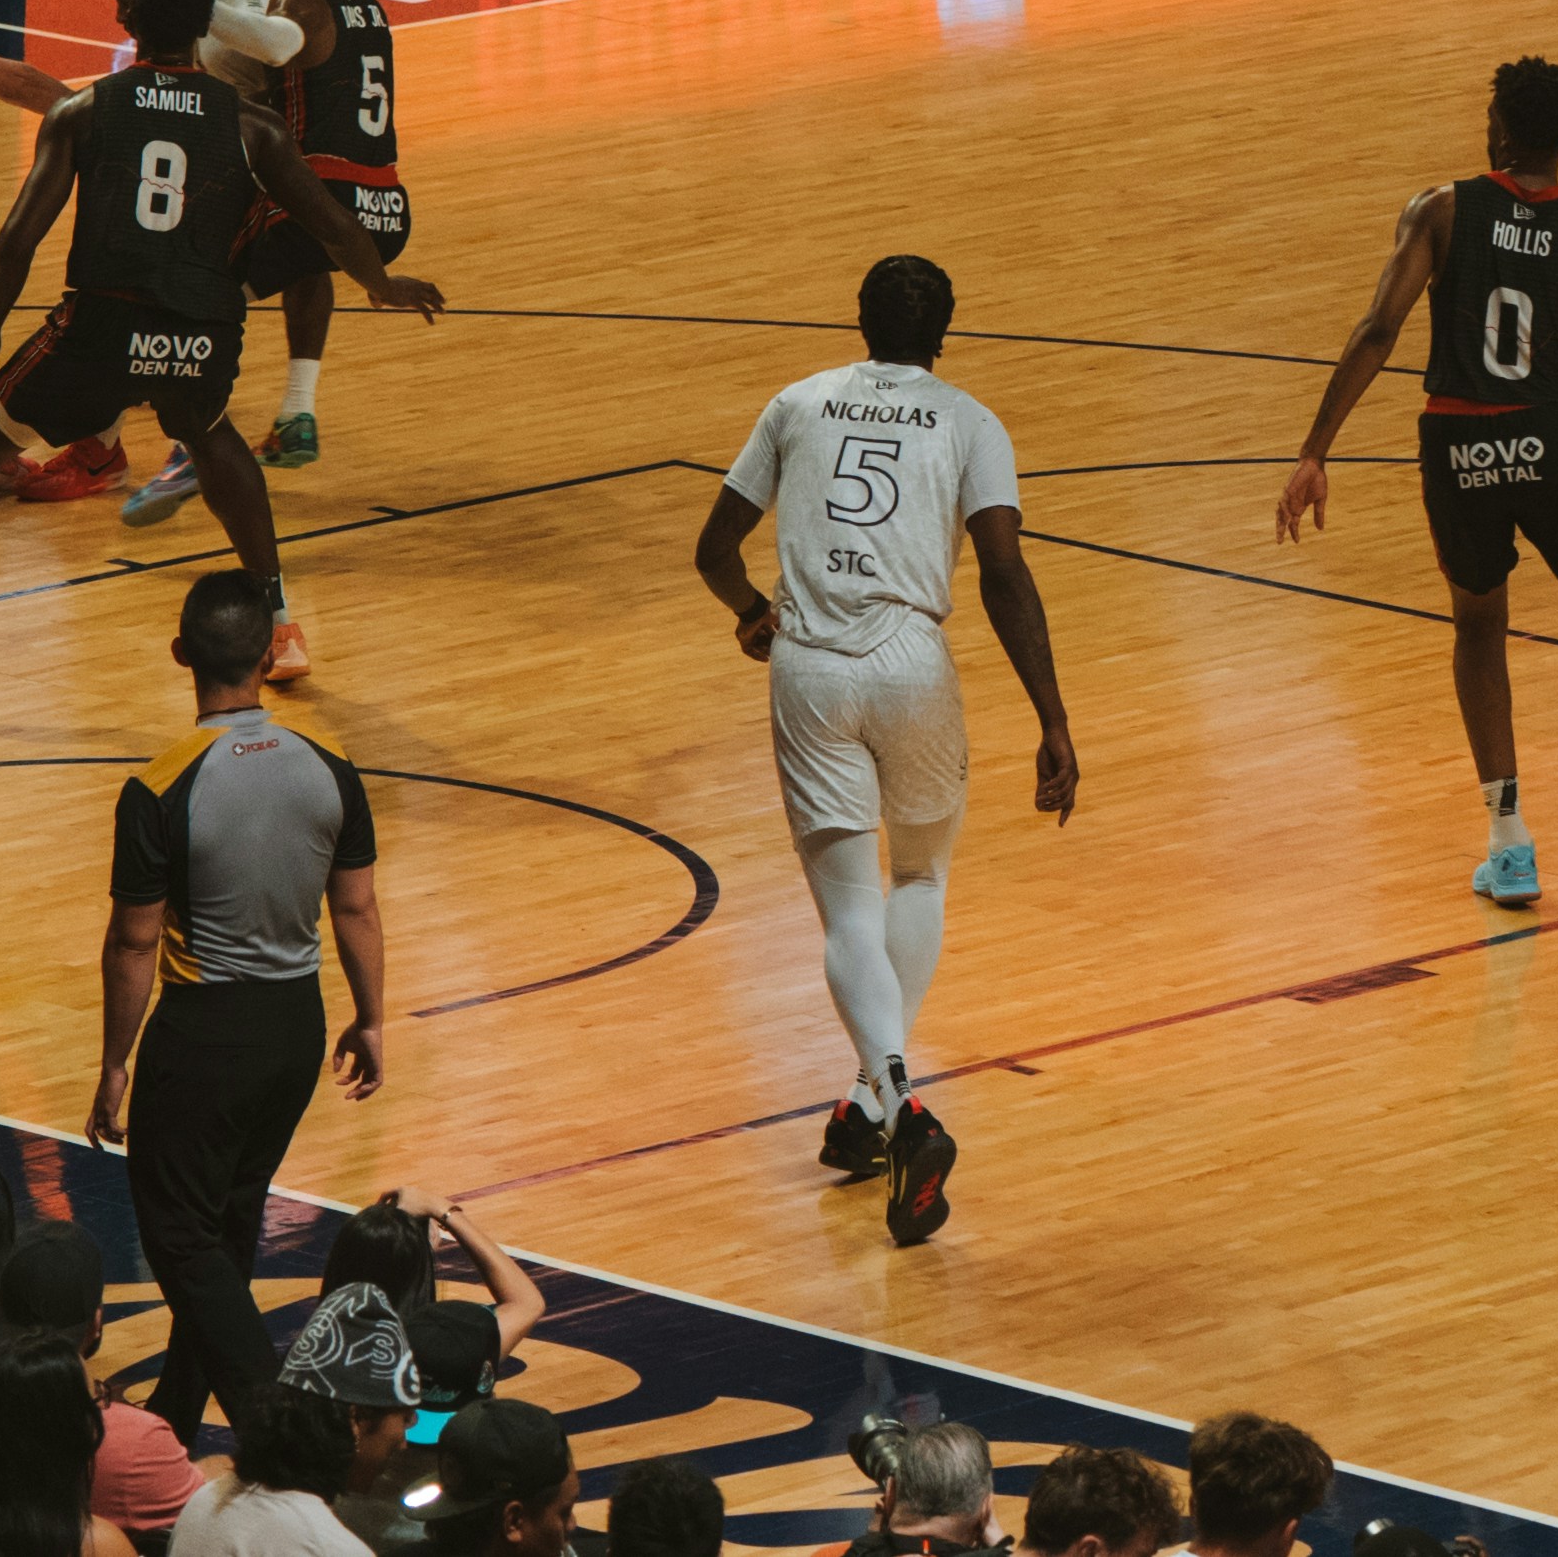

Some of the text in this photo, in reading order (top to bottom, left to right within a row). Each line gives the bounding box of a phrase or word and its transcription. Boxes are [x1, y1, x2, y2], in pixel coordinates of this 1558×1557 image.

[135, 83, 205, 118] SAMUEL
[357, 55, 389, 138] 5
[134, 139, 188, 232] 8
[355, 185, 404, 216] NOVO
[1492, 219, 1553, 257] HOLLIS
[128, 332, 213, 362] NOVO
[1483, 286, 1534, 381] 0
[820, 399, 938, 429] NICHOLAS
[1448, 436, 1545, 471] NOVO
[825, 435, 902, 527] 5
[826, 549, 877, 577] STC
